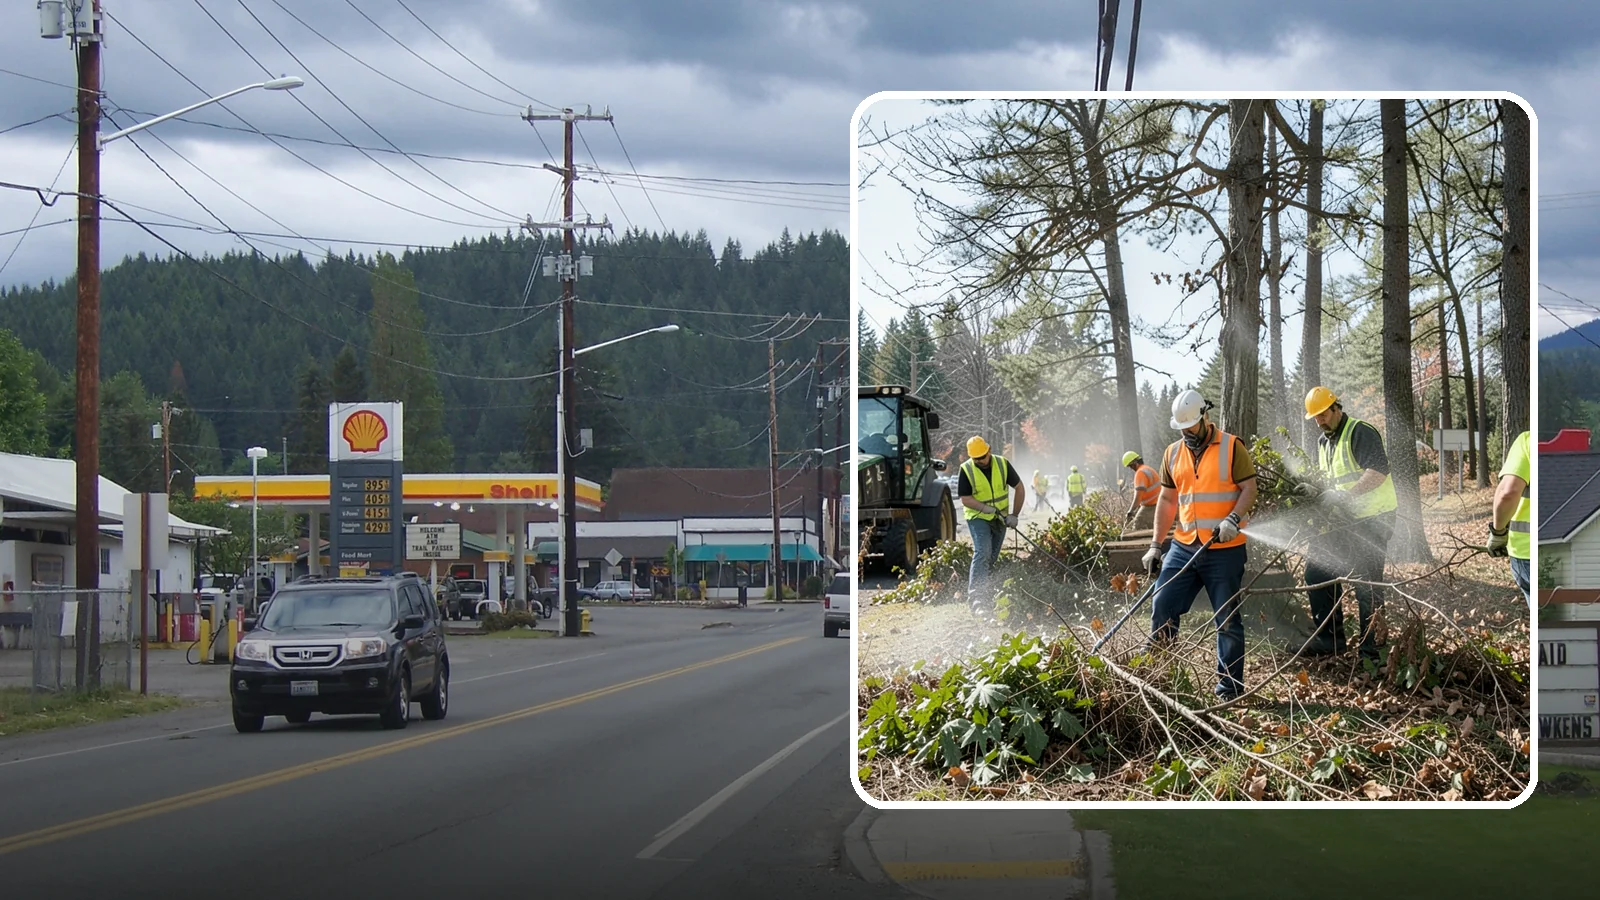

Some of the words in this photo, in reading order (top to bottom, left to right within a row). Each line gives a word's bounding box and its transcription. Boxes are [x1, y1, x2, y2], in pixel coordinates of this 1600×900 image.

[366, 480, 384, 490] 395
[490, 484, 547, 499] Shell
[366, 494, 384, 504] 405
[366, 508, 384, 518] 415
[366, 522, 384, 532] 429
